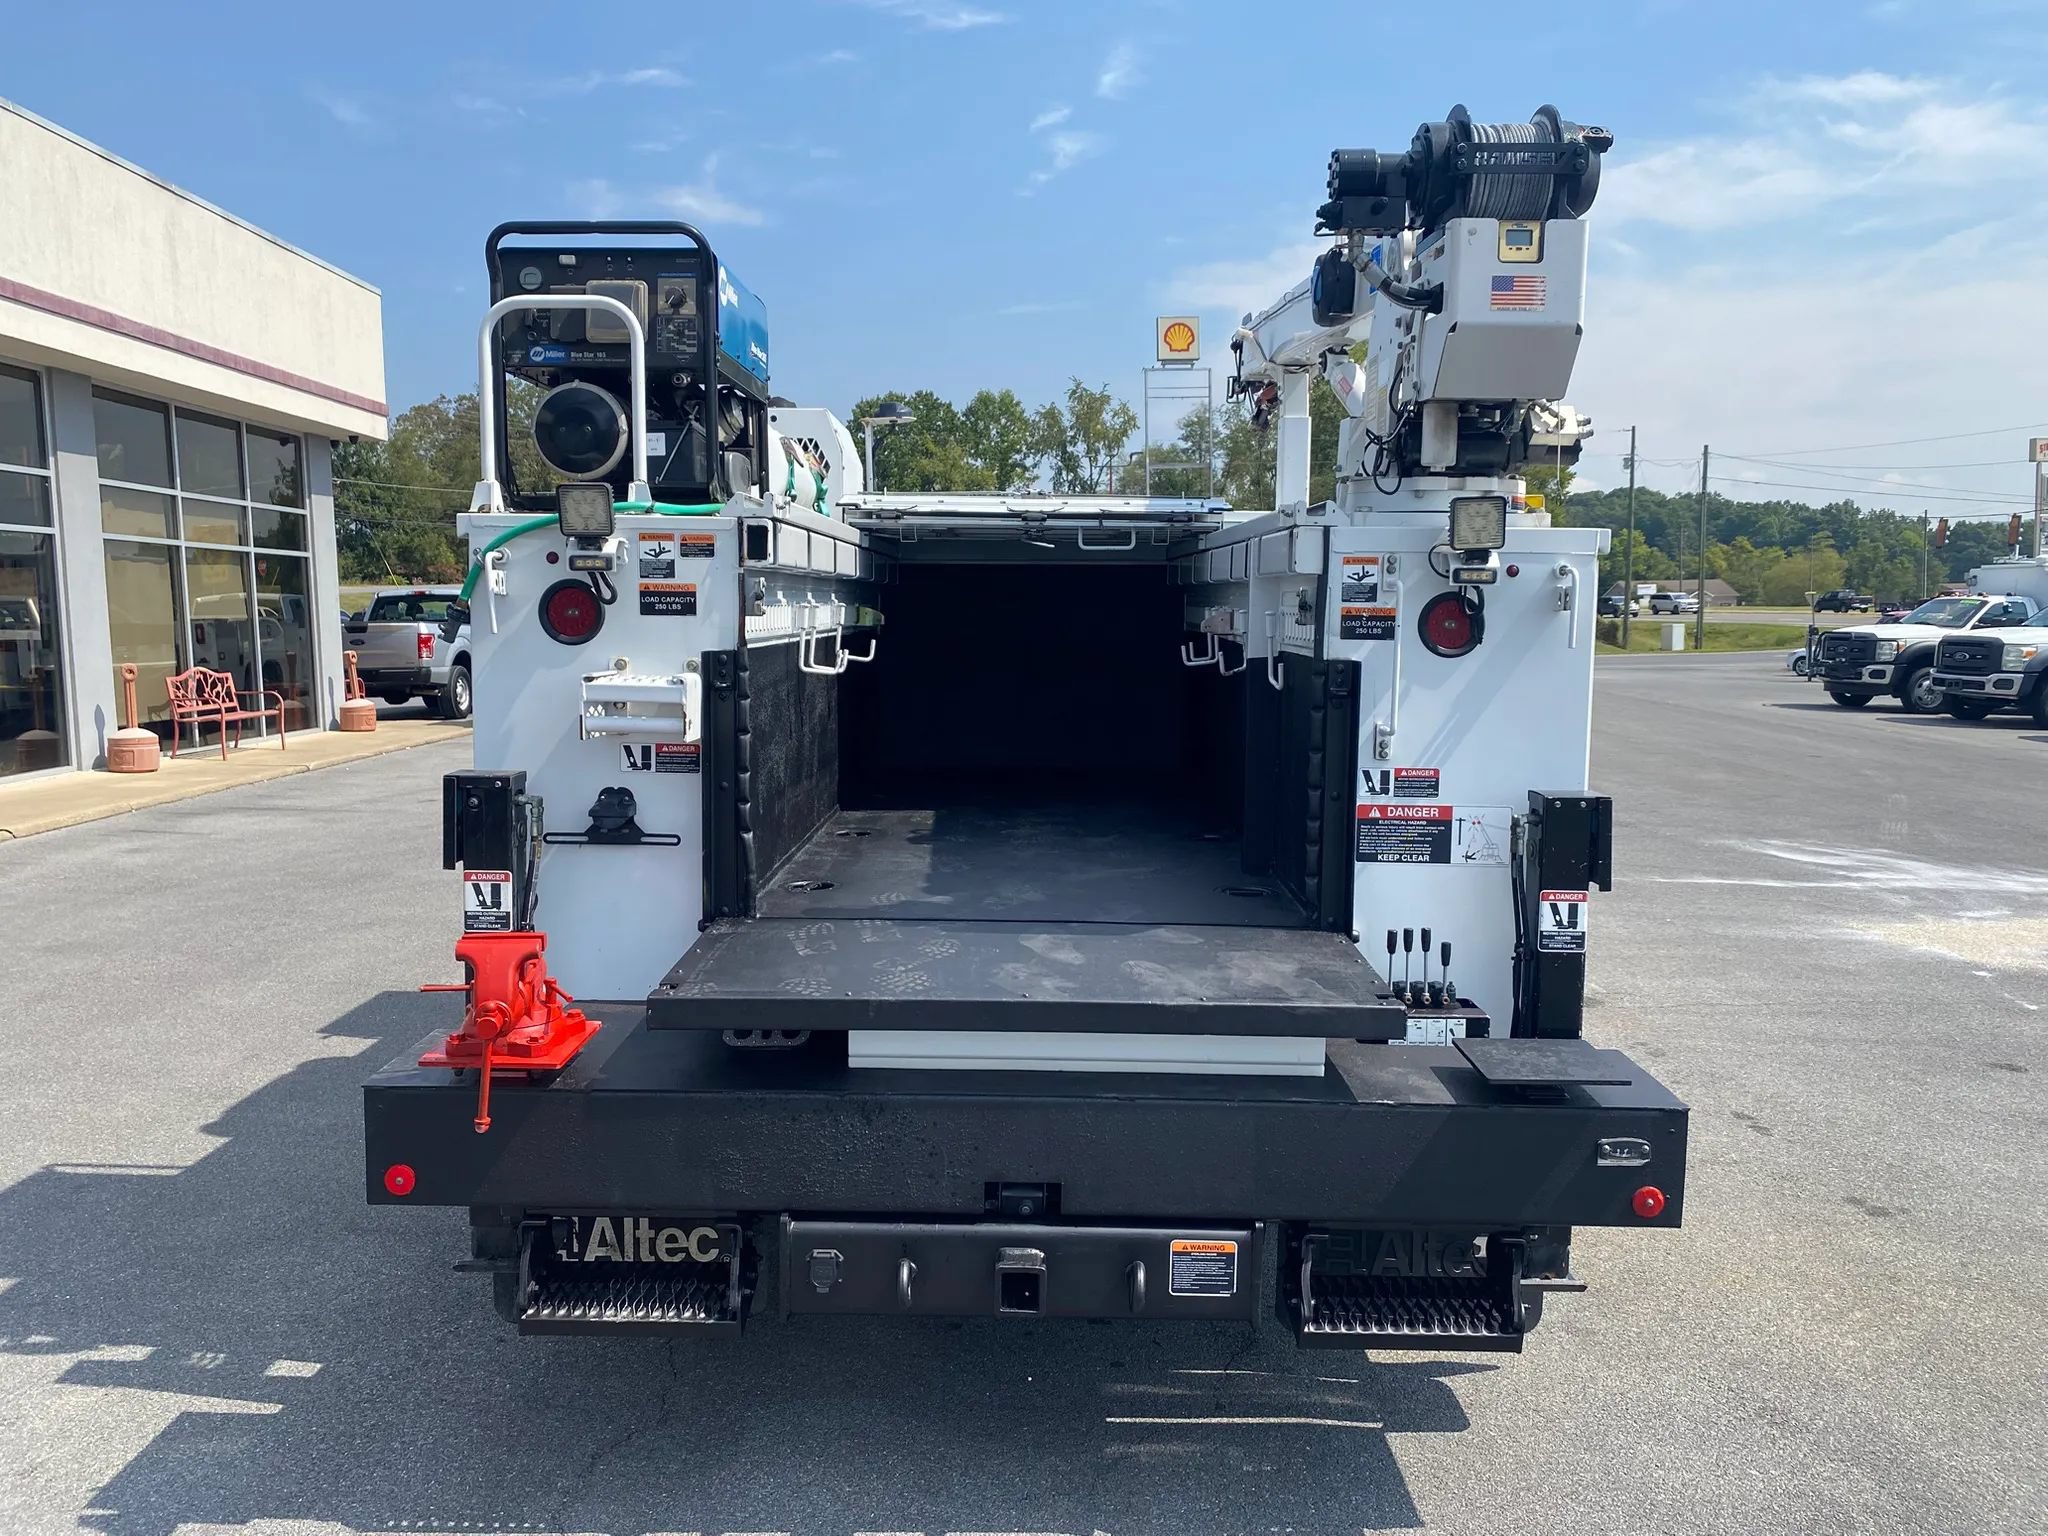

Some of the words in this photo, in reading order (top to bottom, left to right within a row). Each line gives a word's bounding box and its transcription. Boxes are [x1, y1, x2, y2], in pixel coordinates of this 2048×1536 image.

[545, 350, 565, 358] Miller
[1387, 806, 1439, 817] DANGER
[1401, 854, 1430, 862] CLEAR
[584, 1216, 719, 1263] Altec
